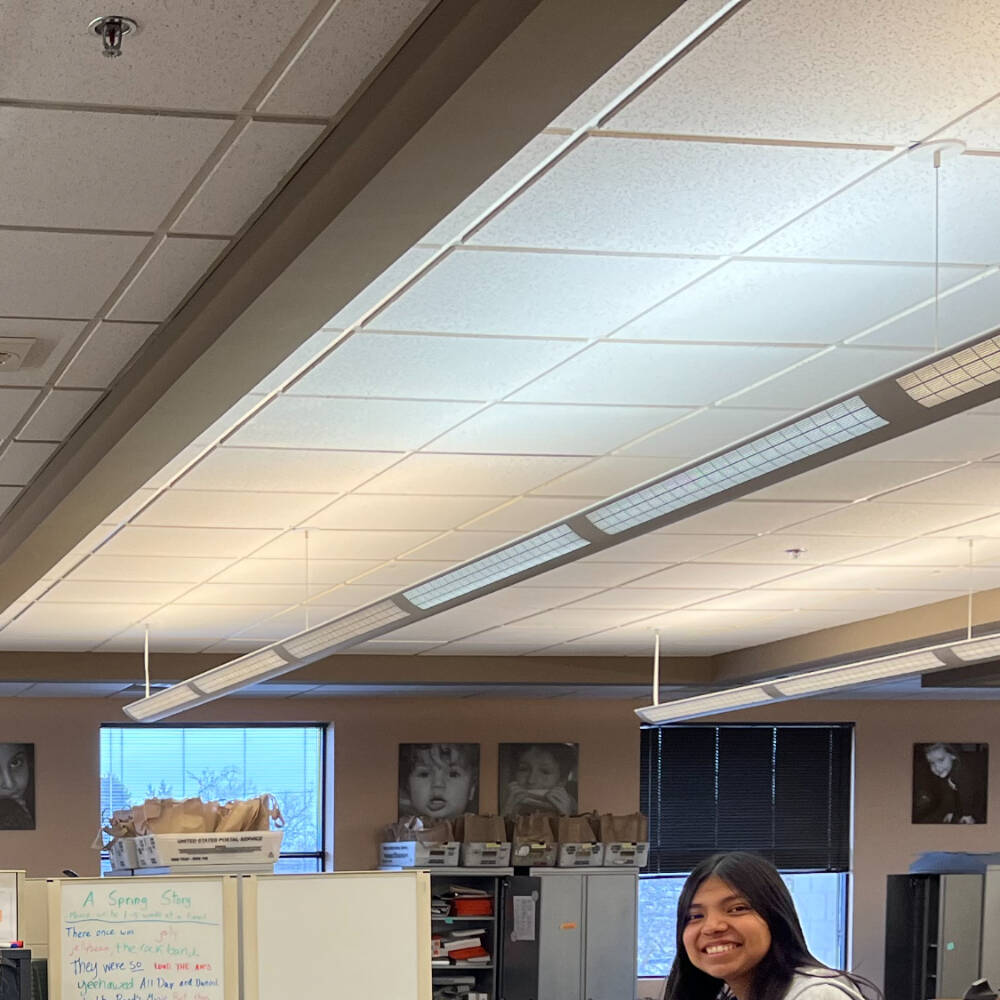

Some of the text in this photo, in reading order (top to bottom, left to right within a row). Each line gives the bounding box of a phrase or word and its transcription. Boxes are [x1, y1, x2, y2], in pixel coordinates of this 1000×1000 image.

[82, 889, 192, 909] A Spring Story
[65, 927, 92, 938] There
[96, 928, 115, 937] once
[70, 958, 98, 980] They
[103, 961, 126, 973] were
